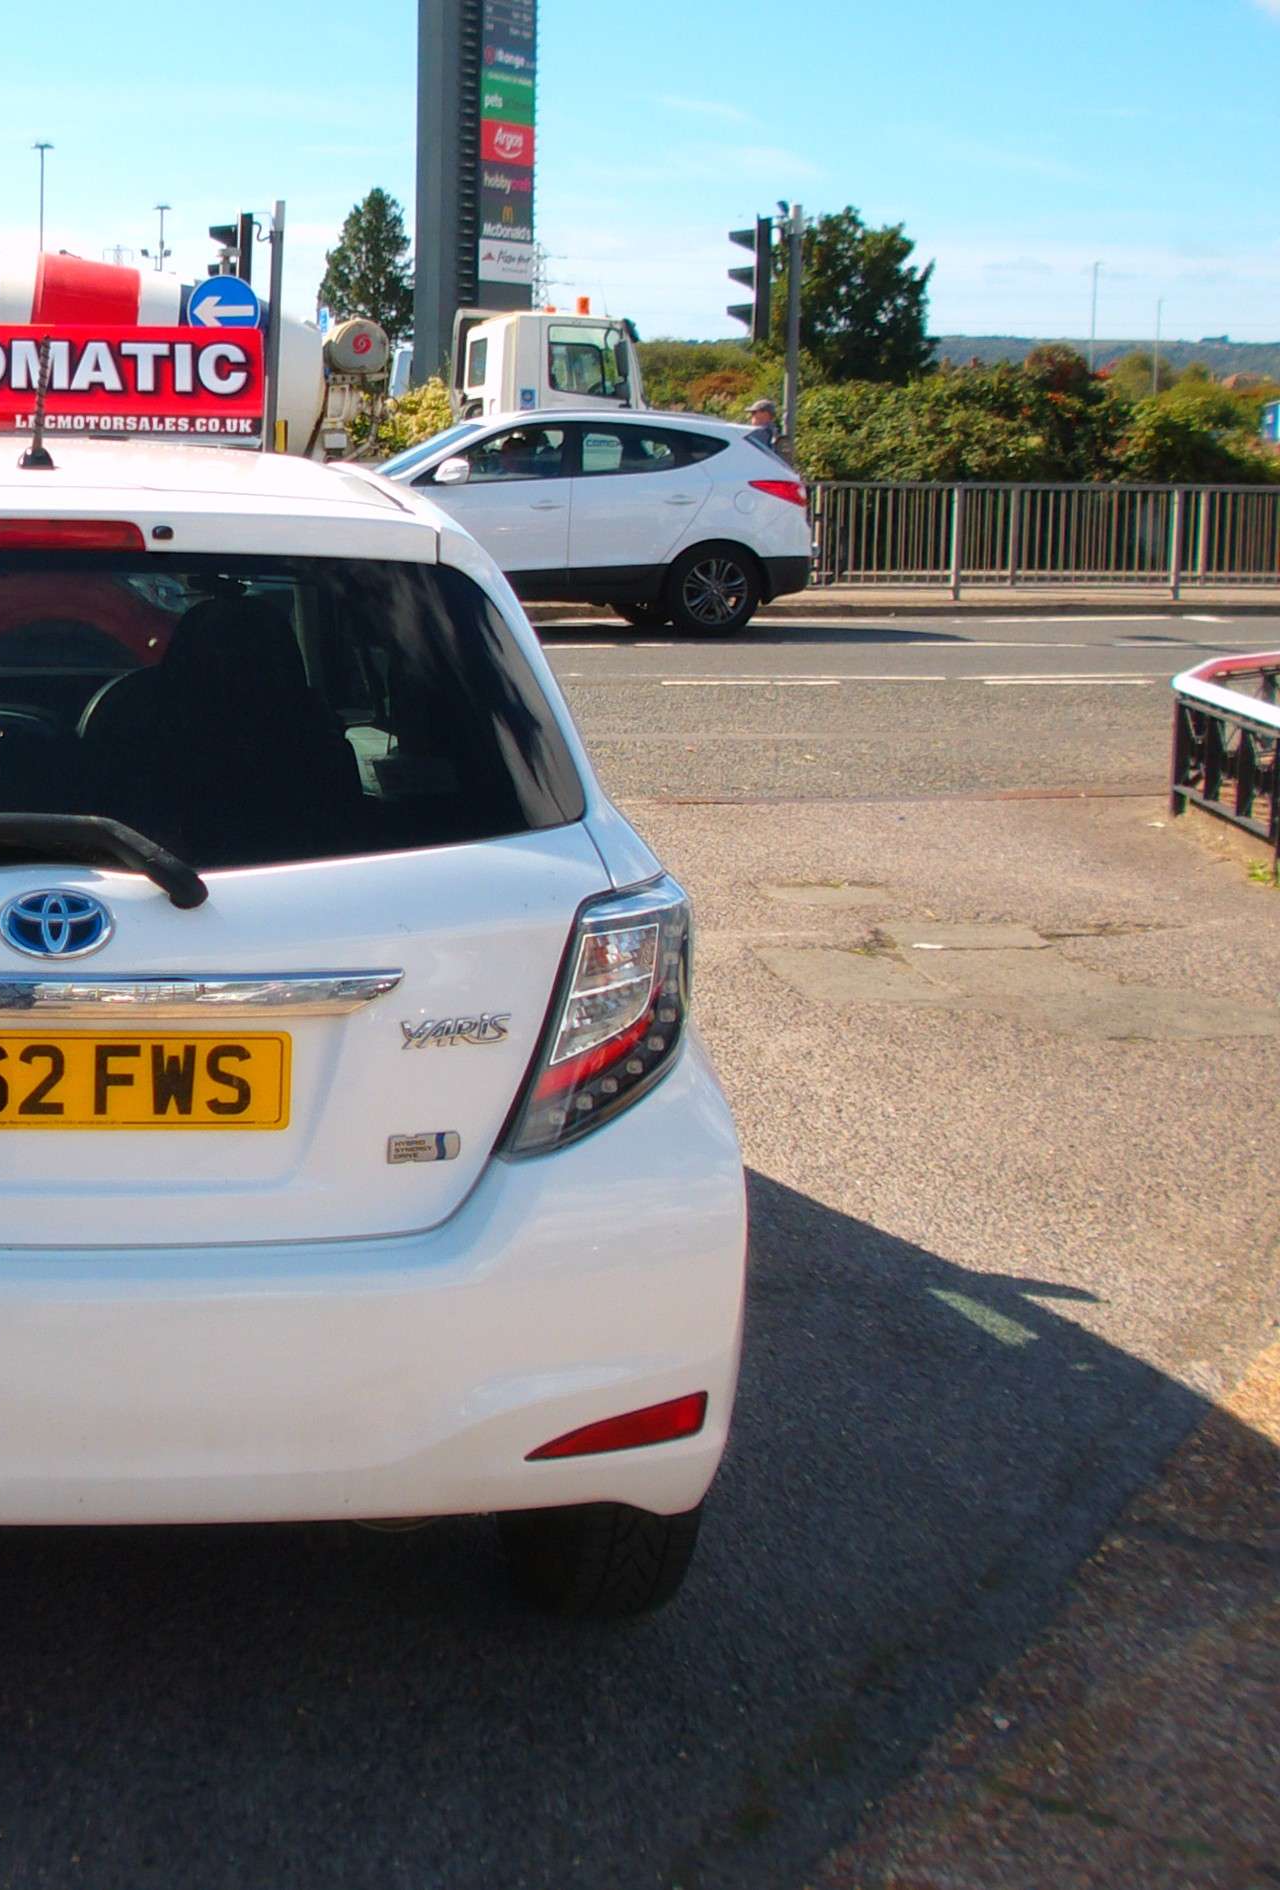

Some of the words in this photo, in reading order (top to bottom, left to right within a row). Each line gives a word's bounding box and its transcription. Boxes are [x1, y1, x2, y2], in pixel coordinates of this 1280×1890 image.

[493, 127, 524, 150] Argos
[482, 221, 531, 241] McDonald's
[93, 1044, 252, 1117] FWS
[394, 1139, 426, 1148] HYBRID
[394, 1145, 433, 1154] SYNERGY
[393, 1152, 419, 1160] DRIVE
